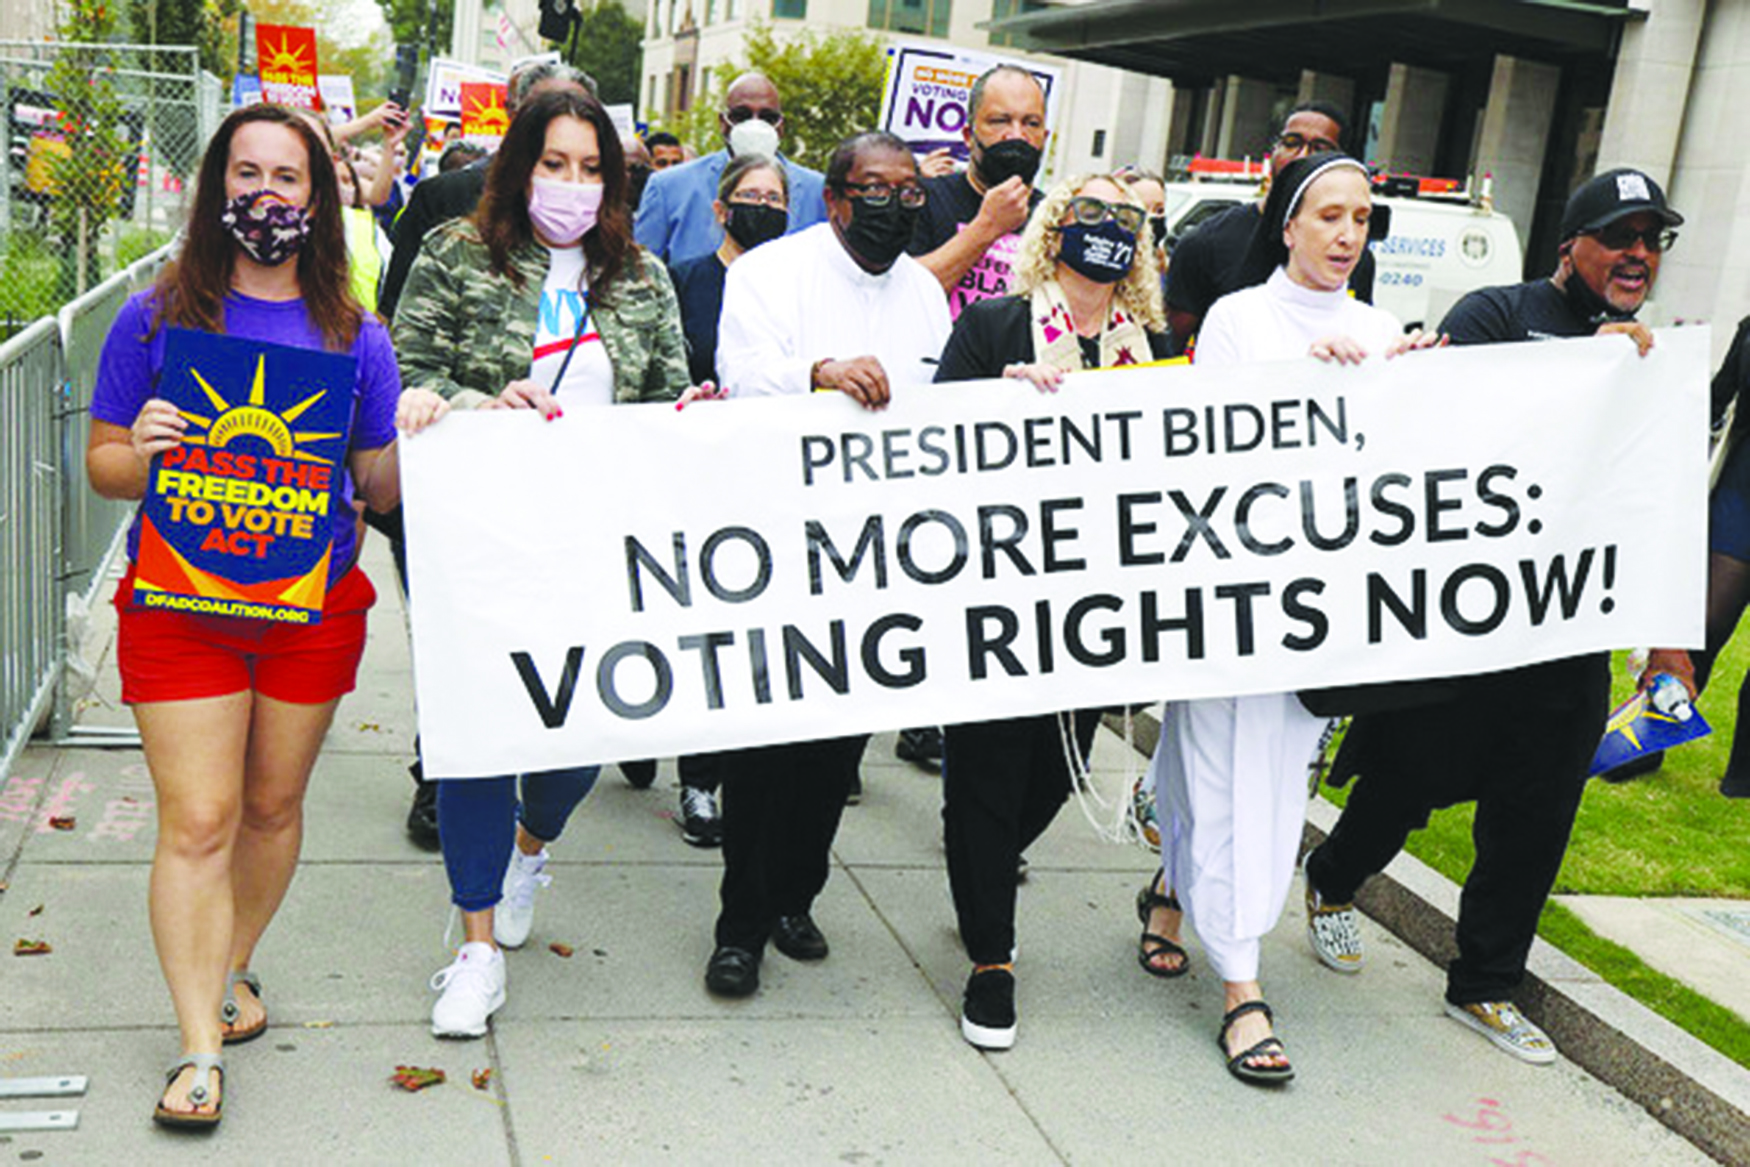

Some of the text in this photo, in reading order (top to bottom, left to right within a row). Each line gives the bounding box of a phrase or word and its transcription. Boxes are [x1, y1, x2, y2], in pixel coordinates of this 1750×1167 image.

[913, 83, 967, 101] VOTING
[904, 97, 967, 132] NO
[1381, 236, 1446, 257] SERVICES
[802, 397, 1366, 487] PRESIDENT BIDEN,
[162, 446, 331, 490] PASS THE
[156, 469, 330, 517] FREEDOM
[166, 496, 315, 539] TO VOTE
[625, 464, 1544, 613] NO MORE EXCUSES:
[200, 527, 275, 559] ACT
[144, 593, 310, 624] DFADCOALITION.ORG
[510, 543, 1618, 730] VOTING RIGHTS NOW!
